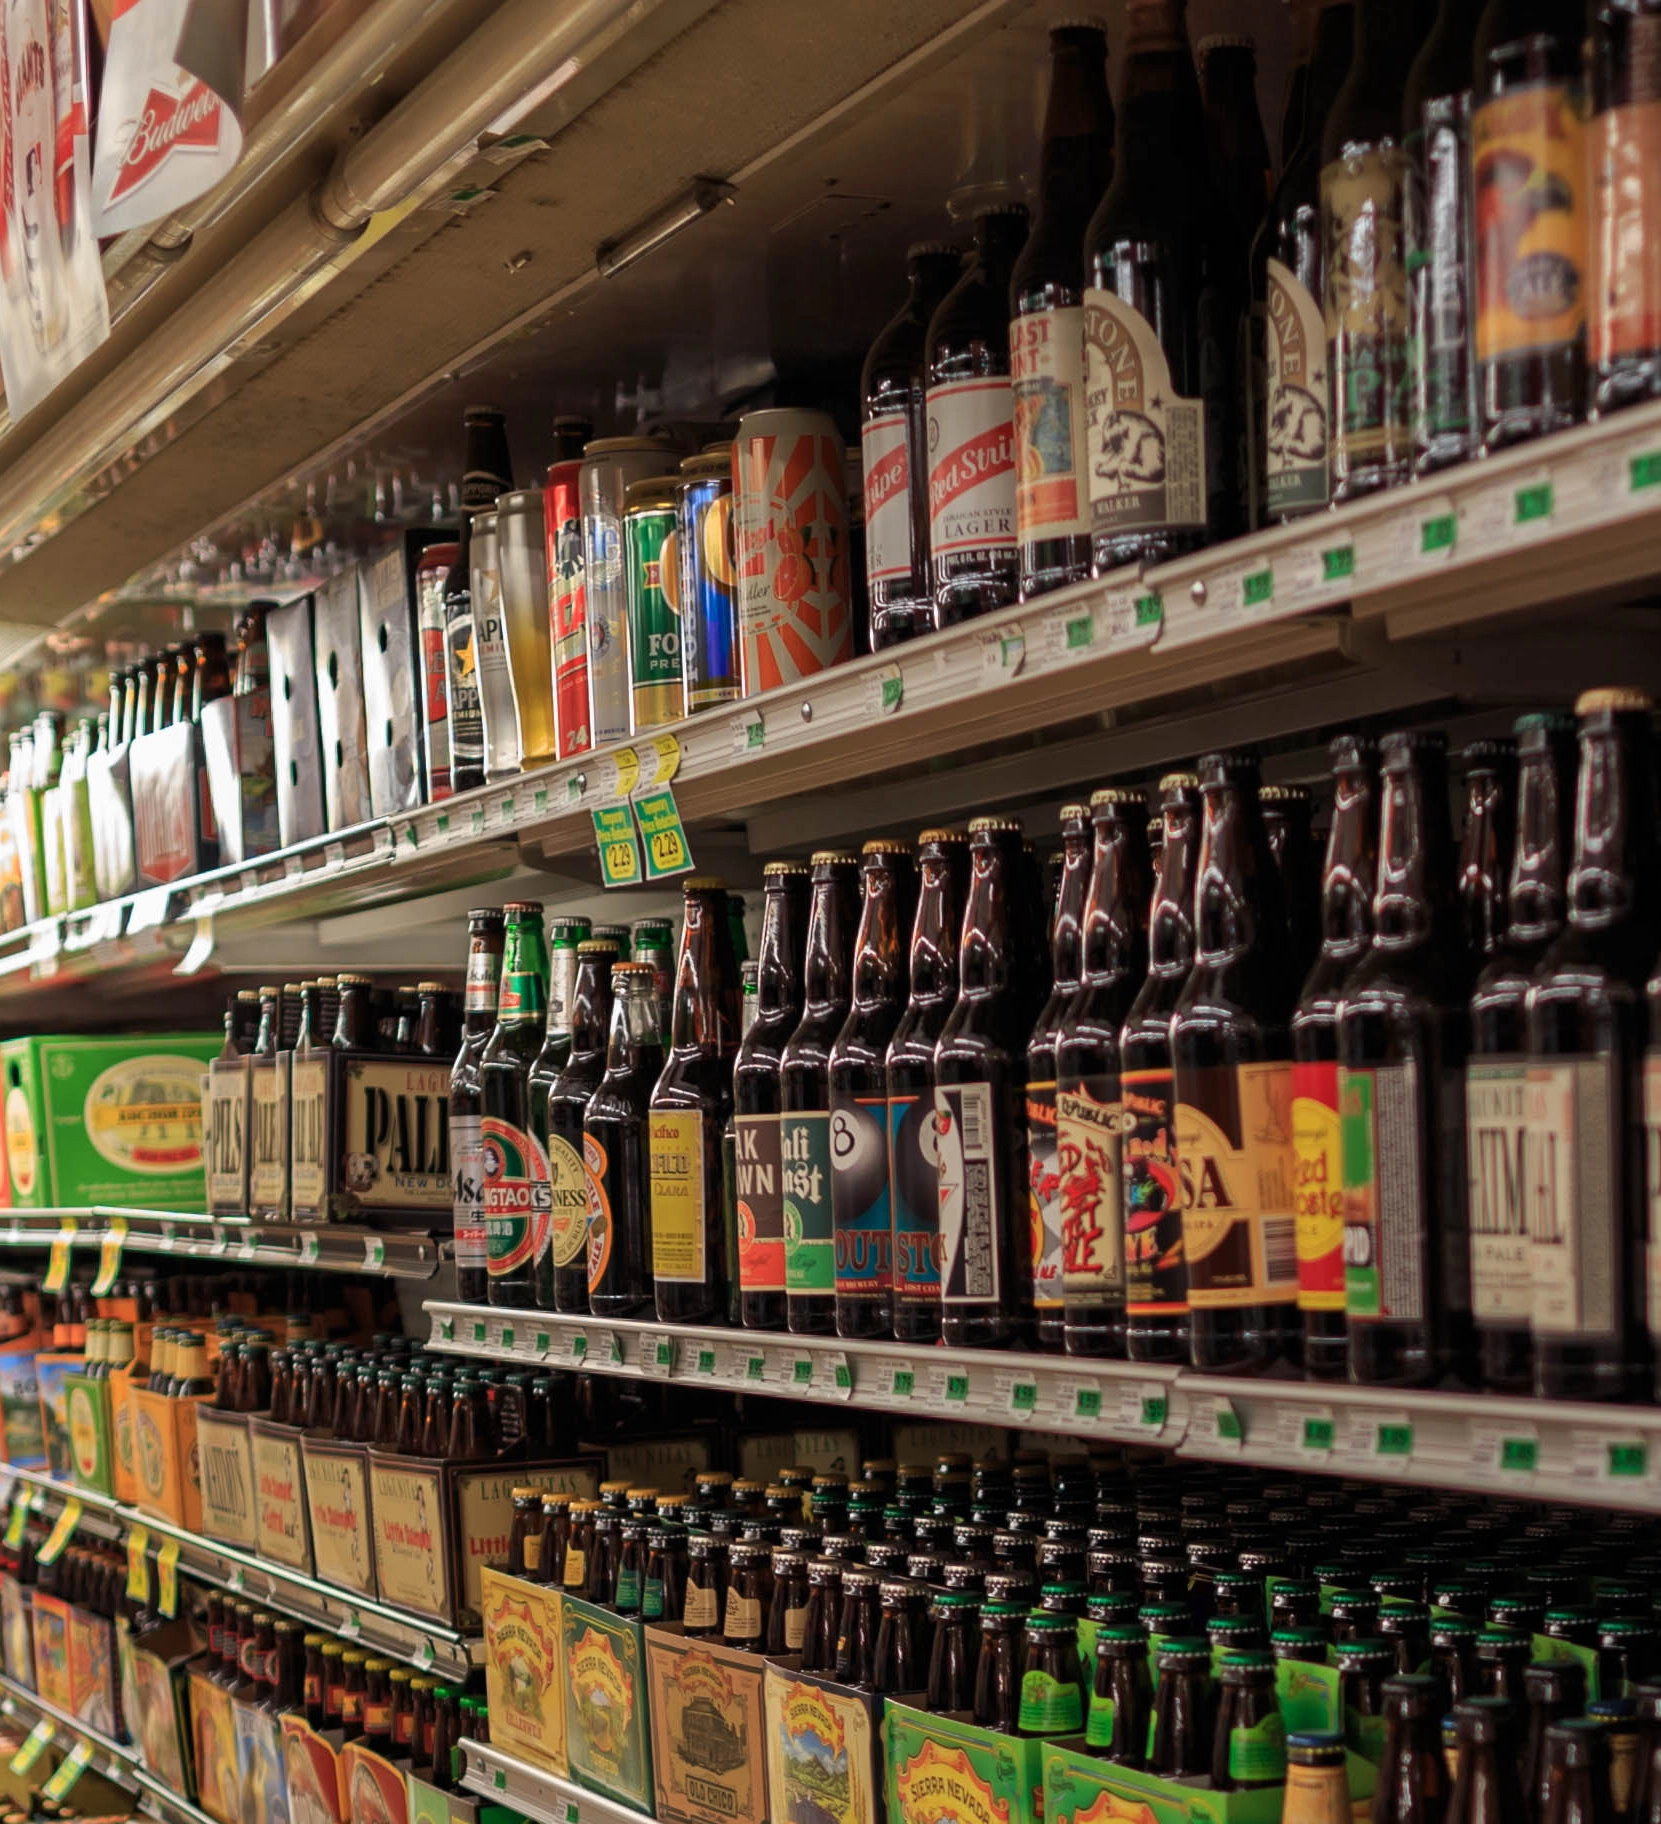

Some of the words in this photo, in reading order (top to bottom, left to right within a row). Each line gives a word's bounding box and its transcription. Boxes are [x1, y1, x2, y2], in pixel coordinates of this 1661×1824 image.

[116, 88, 221, 170] Budweis
[1269, 284, 1302, 377] ONE
[982, 507, 1012, 519] STYLE
[944, 520, 1012, 538] LAGER
[652, 832, 678, 857] $2.29
[833, 1117, 855, 1157] 8
[395, 1175, 428, 1188] NEW
[689, 1780, 706, 1800] OLD
[707, 1785, 734, 1812] CHICO
[910, 1777, 945, 1804] SIERRA
